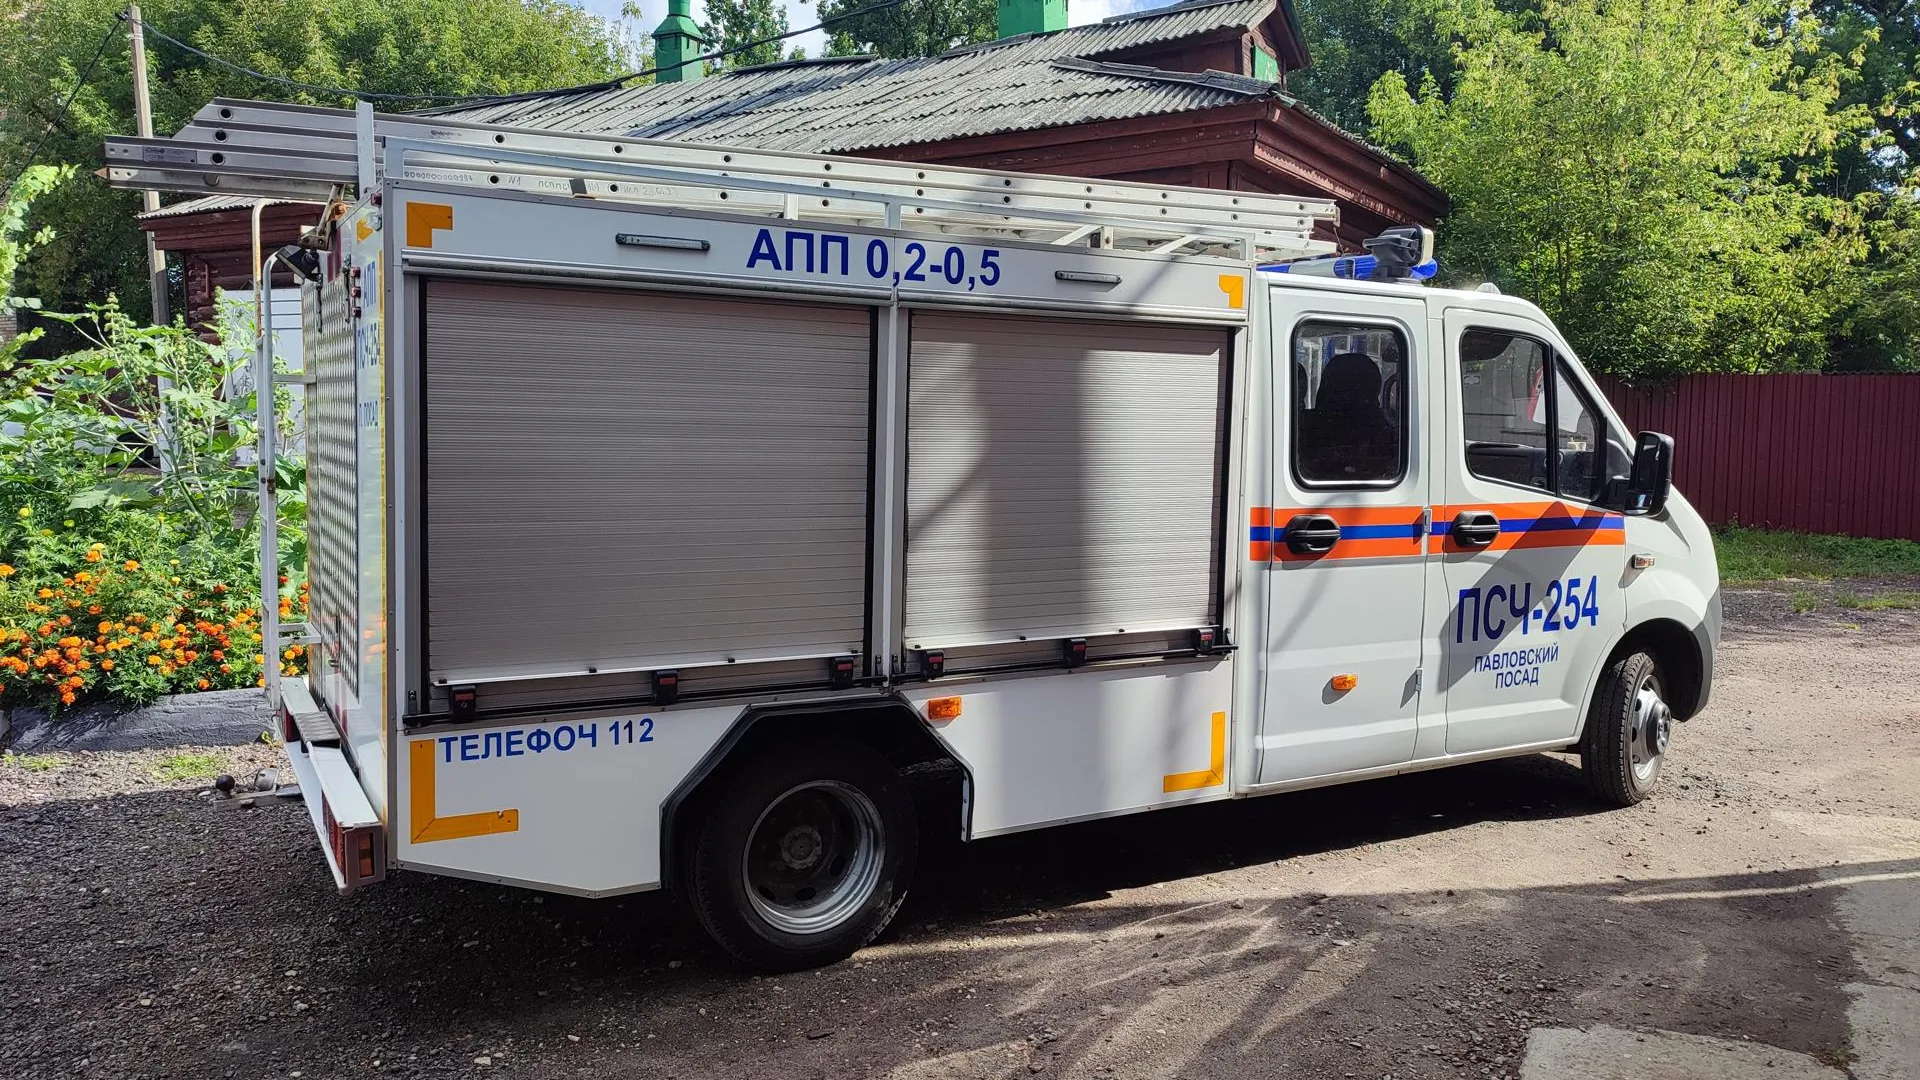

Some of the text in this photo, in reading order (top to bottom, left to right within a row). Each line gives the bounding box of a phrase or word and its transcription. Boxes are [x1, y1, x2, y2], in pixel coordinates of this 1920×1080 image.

[746, 229, 1001, 291] АПП 0,2-0,5
[1456, 575, 1599, 644] ПСЧ-254
[1474, 642, 1559, 673] ПАВЛОВСКИЙ
[1495, 667, 1540, 689] ПОСАД
[608, 718, 654, 746] 112
